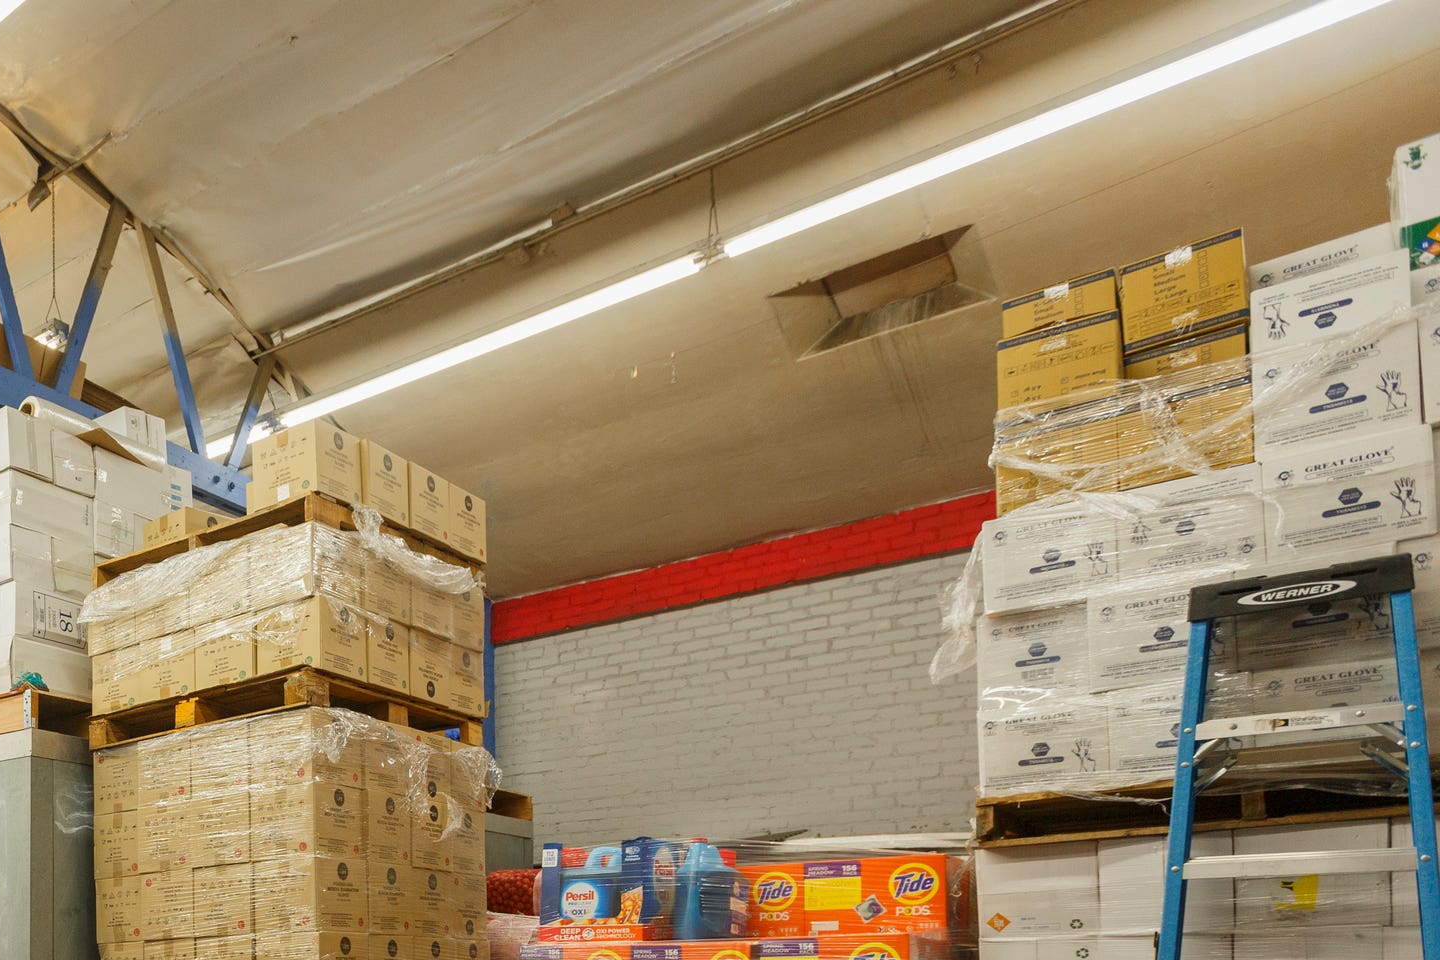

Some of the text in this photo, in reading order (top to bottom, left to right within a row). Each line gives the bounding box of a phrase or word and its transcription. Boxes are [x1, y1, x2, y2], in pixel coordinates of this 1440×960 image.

[1283, 247, 1355, 274] GREAT GLOVE
[1305, 459, 1345, 473] GREAT
[1350, 449, 1391, 463] GLOVE
[1125, 599, 1161, 609] GREAT
[1261, 584, 1333, 602] WERNER
[60, 611, 73, 633] 18
[1294, 666, 1382, 685] GREAT GLOVE
[565, 890, 594, 901] Persil
[758, 880, 793, 904] Tide
[894, 873, 934, 899] Tide
